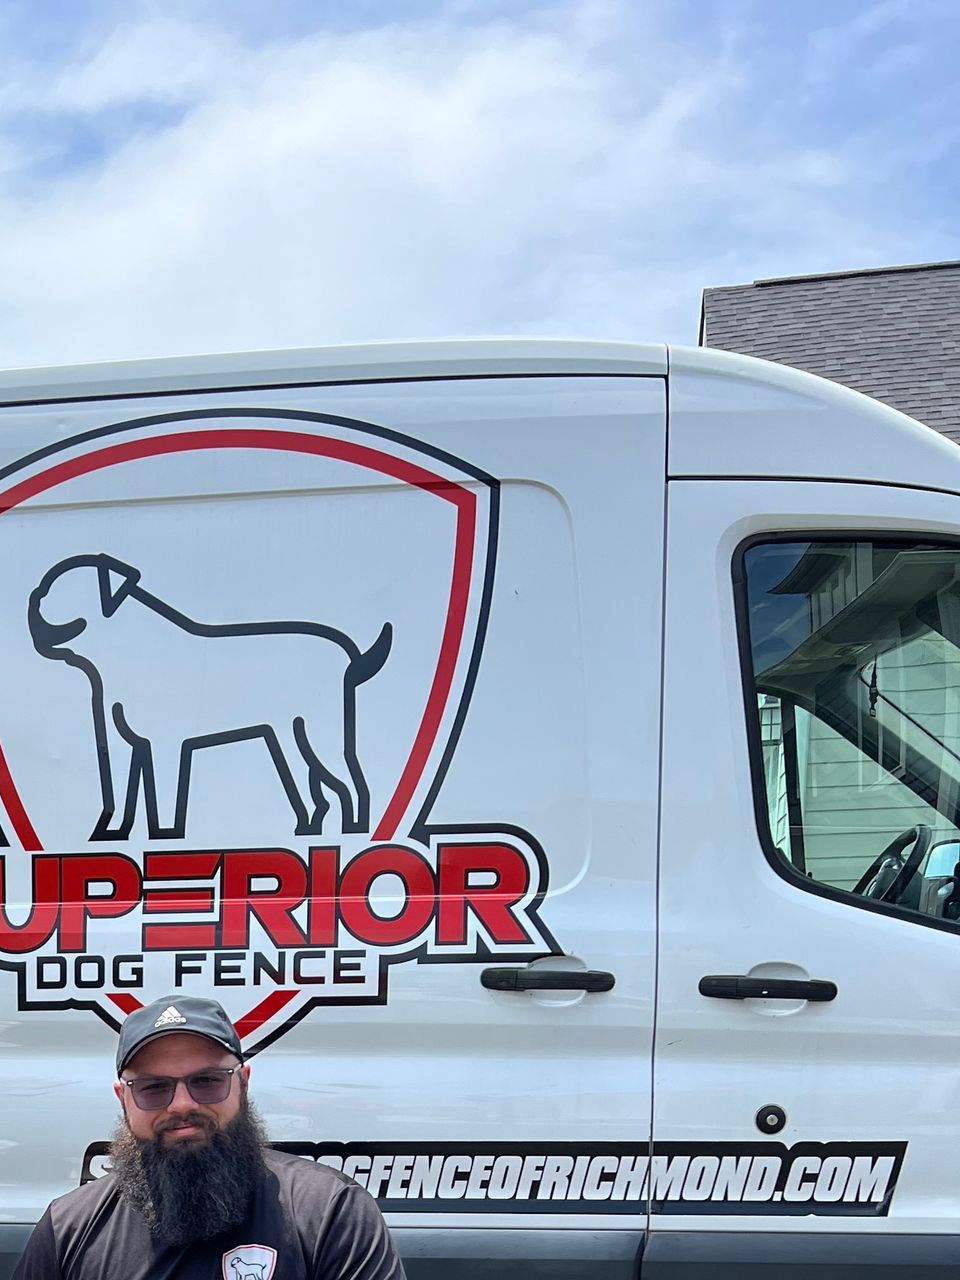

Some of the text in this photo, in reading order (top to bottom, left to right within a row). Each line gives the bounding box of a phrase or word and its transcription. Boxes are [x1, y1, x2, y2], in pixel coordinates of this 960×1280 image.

[36, 949, 368, 990] DOG FENCE
[153, 1015, 188, 1029] adidas
[86, 1154, 894, 1203] GFENCEOFRICHMOND.COM
